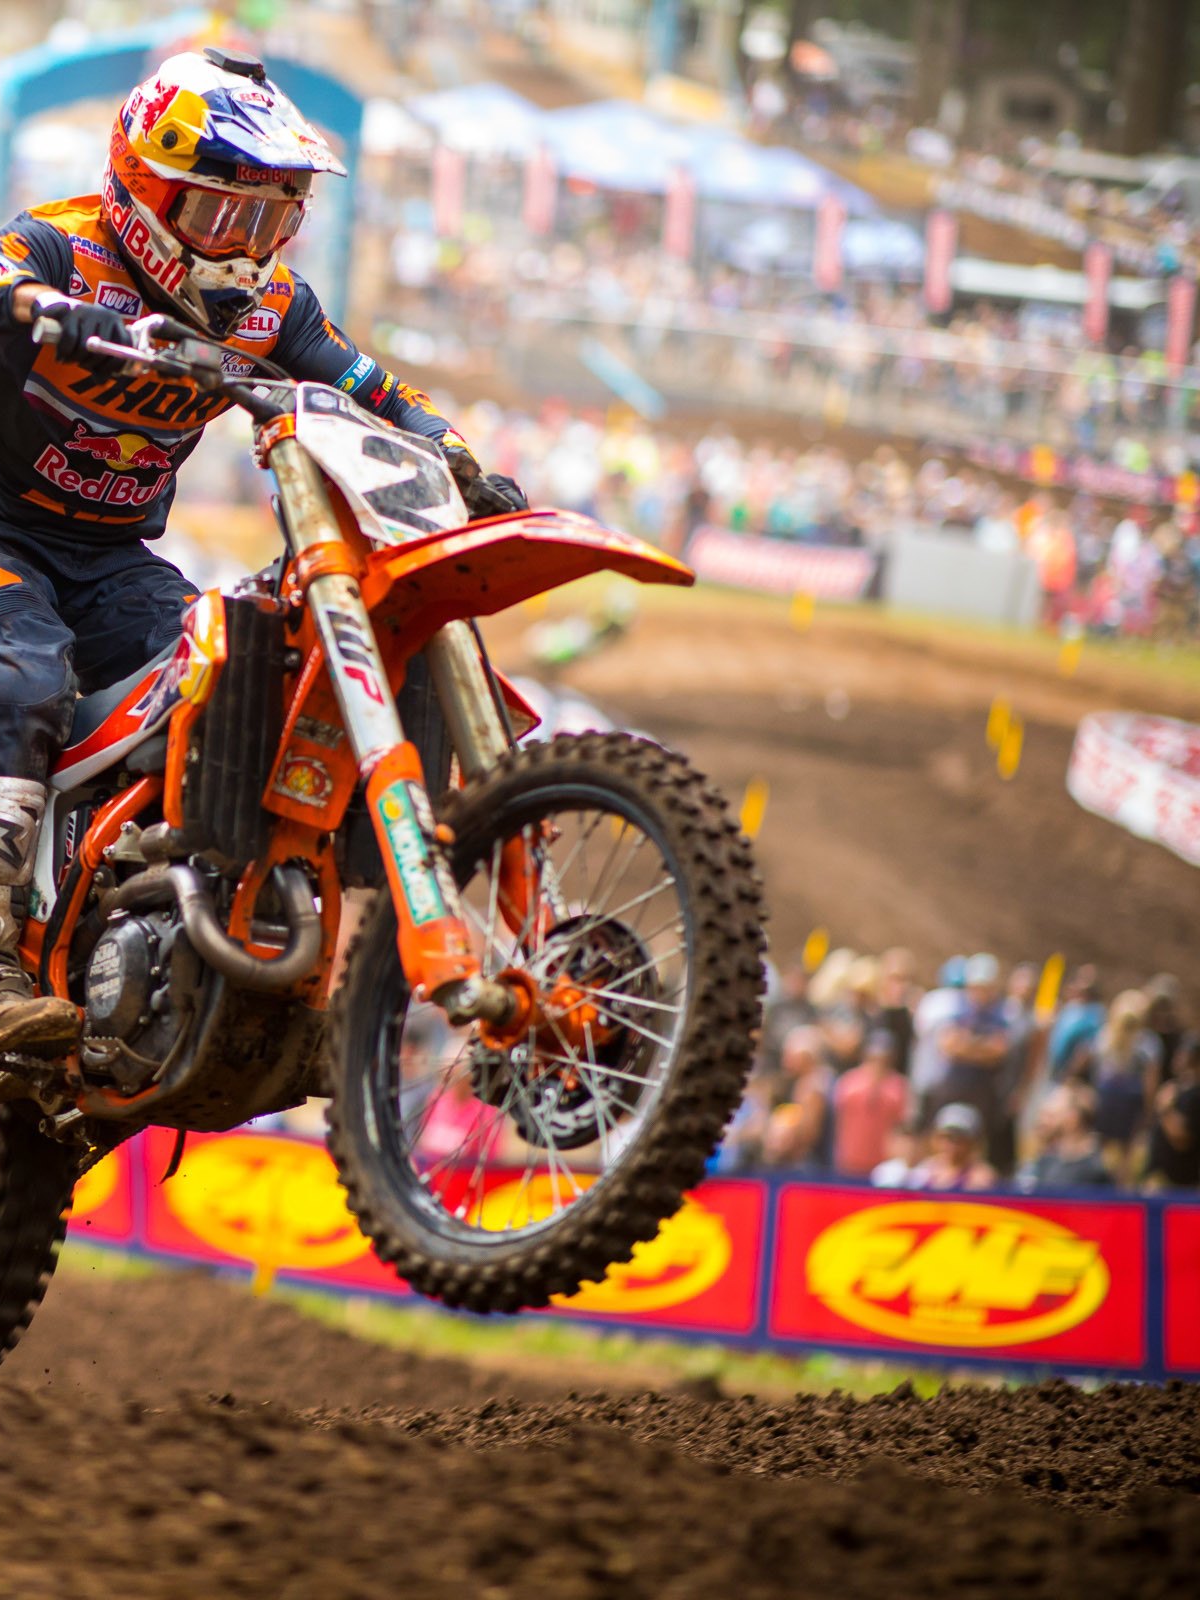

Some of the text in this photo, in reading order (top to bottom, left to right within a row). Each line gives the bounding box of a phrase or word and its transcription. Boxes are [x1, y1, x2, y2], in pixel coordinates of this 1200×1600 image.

[237, 164, 296, 186] Red Bull
[69, 234, 122, 262] PARTS
[71, 245, 127, 271] UNLIMITED
[123, 216, 187, 296] Bull
[100, 288, 136, 314] 100%
[33, 443, 172, 507] Red Bull
